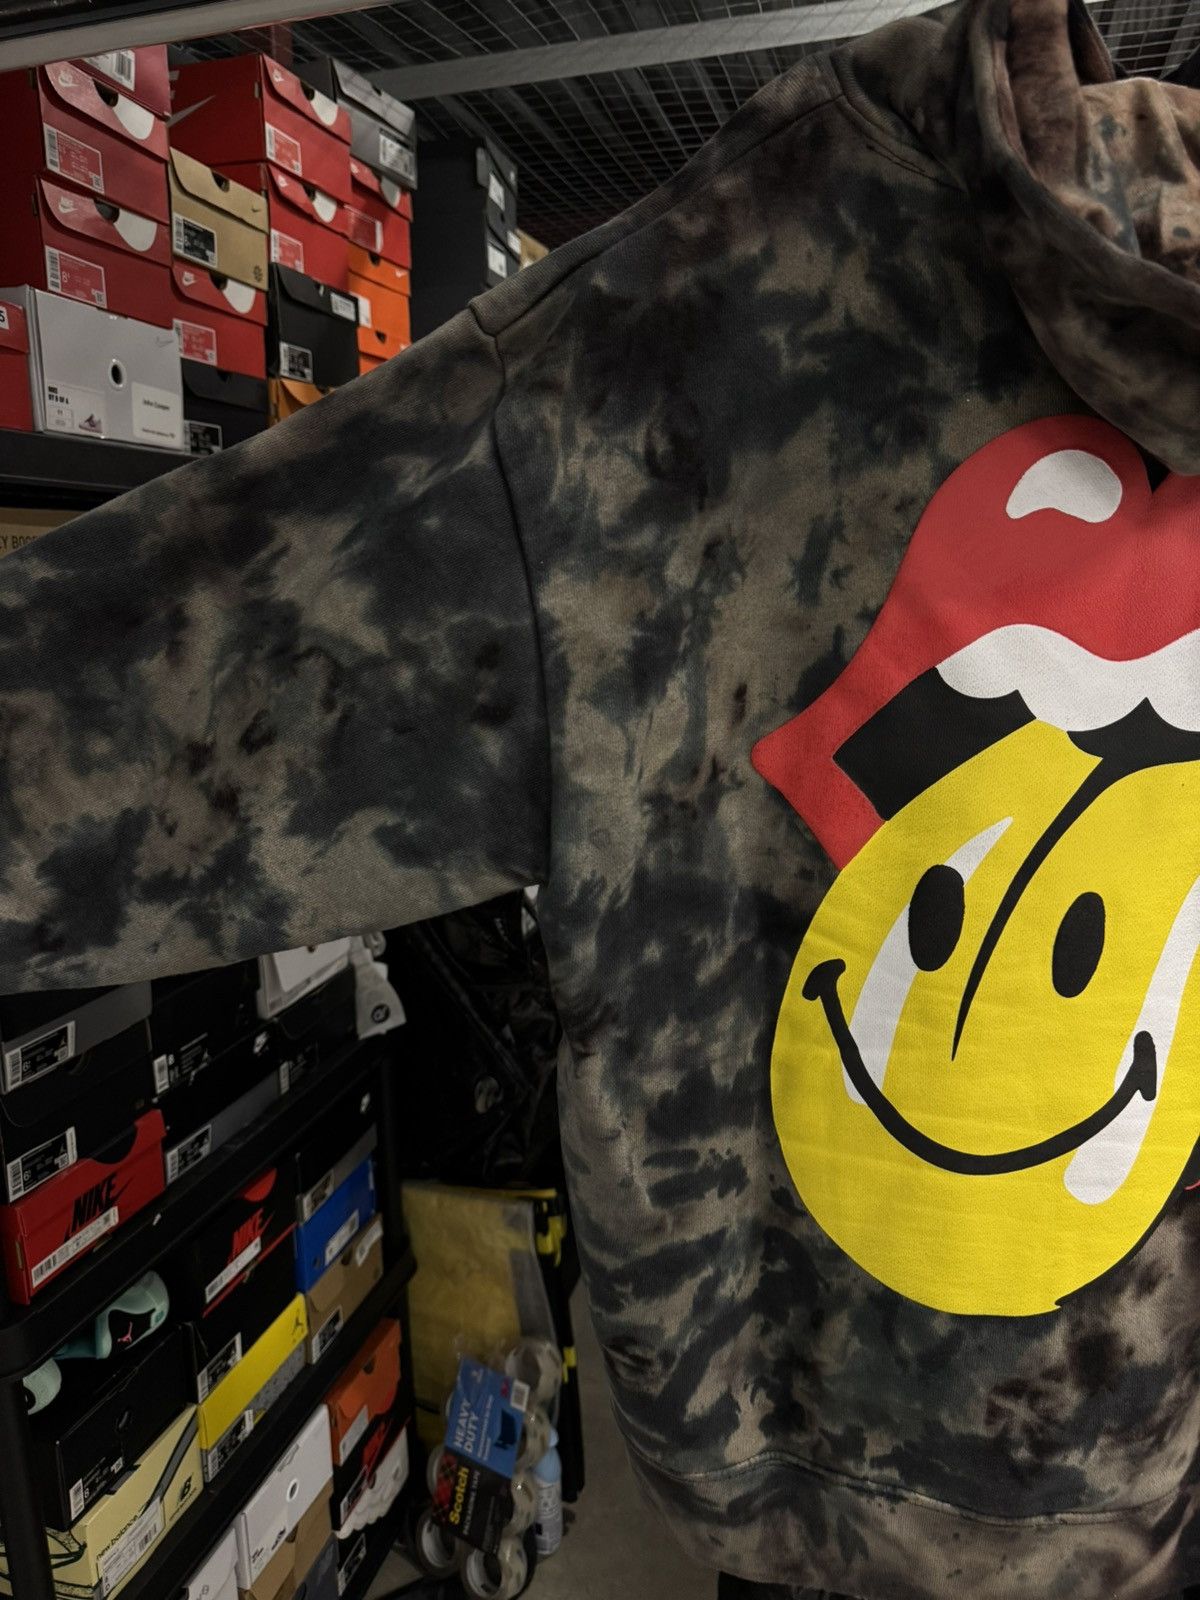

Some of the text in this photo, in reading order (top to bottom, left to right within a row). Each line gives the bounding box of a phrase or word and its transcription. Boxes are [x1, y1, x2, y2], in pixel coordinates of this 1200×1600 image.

[70, 1171, 118, 1233] NIKE
[453, 1397, 472, 1449] HEAVY
[463, 1411, 480, 1453] DUTY
[448, 1465, 470, 1525] Scotch
[96, 1515, 138, 1560] new balance
